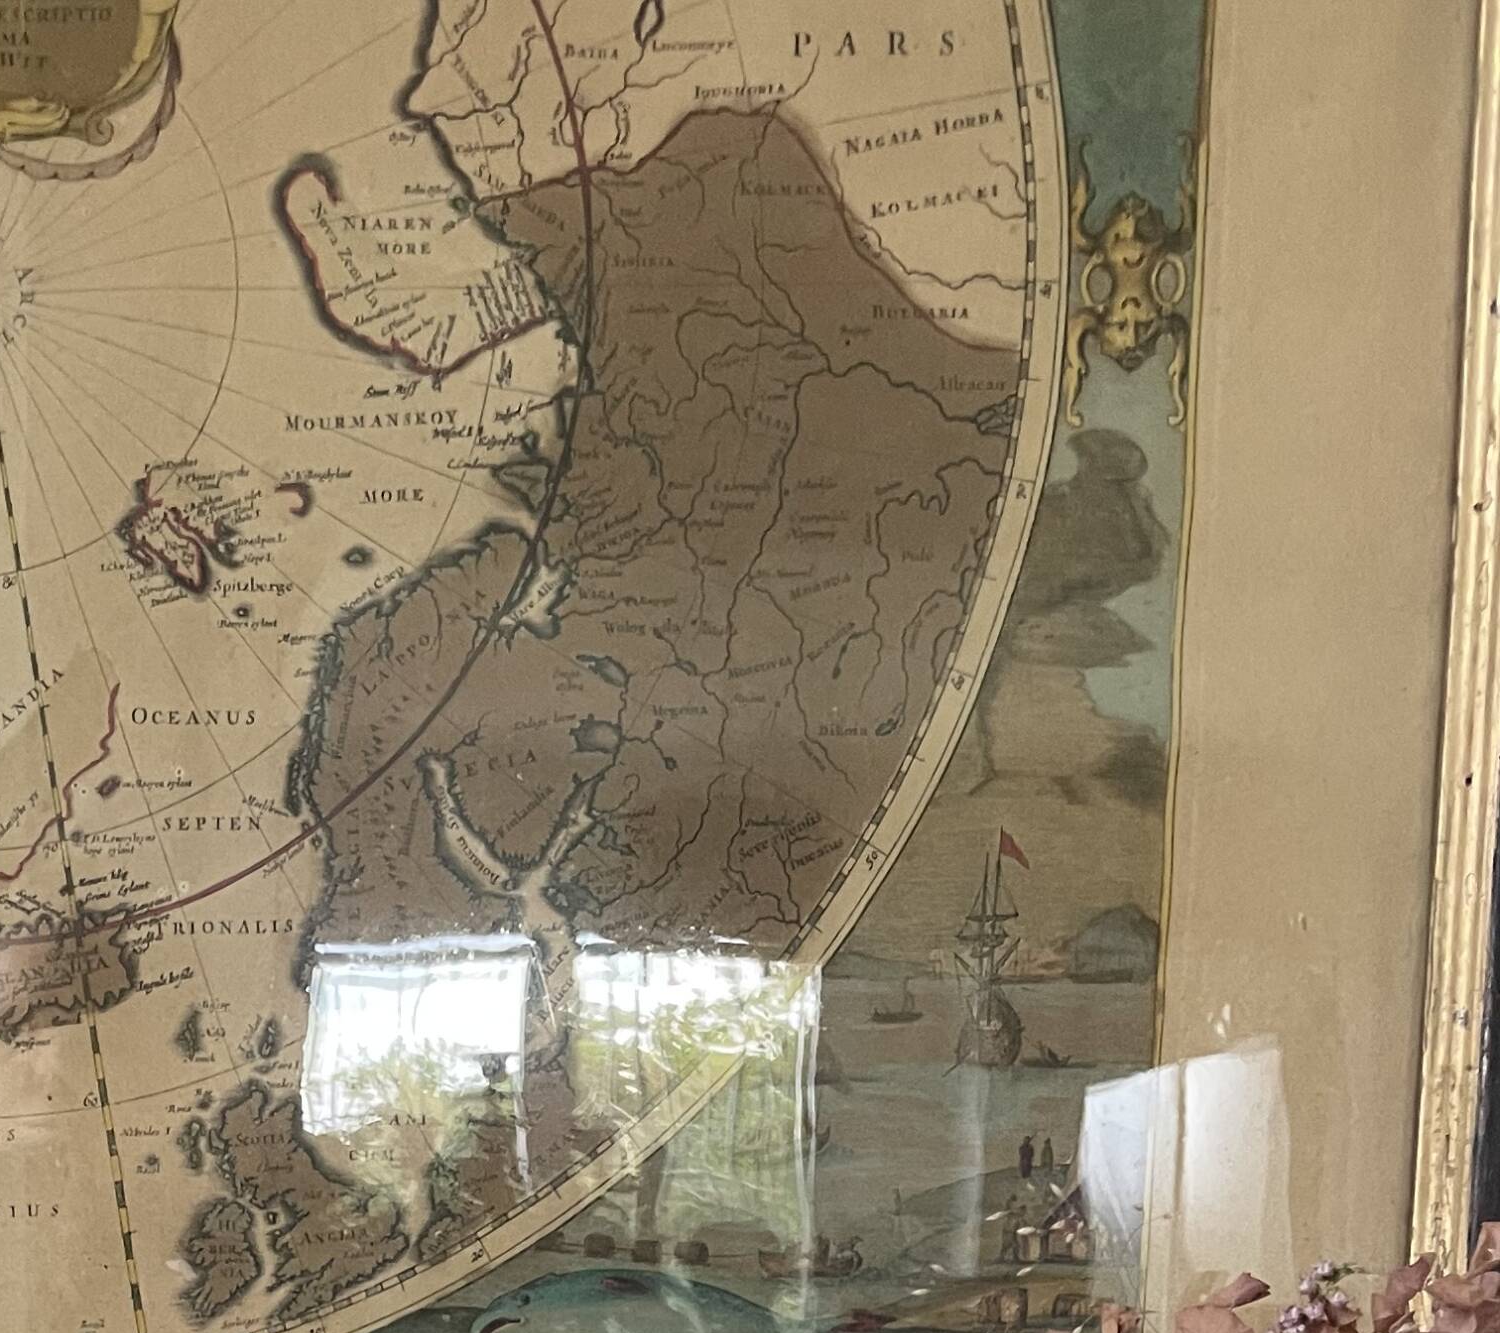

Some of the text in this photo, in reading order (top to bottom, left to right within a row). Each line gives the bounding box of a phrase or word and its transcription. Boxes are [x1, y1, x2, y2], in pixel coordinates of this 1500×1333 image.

[793, 30, 956, 57] PARS
[284, 409, 459, 432] MOURMANSKOY
[362, 487, 425, 505] MORE
[131, 706, 257, 727] OCEANUS
[161, 816, 261, 833] SEPTEN
